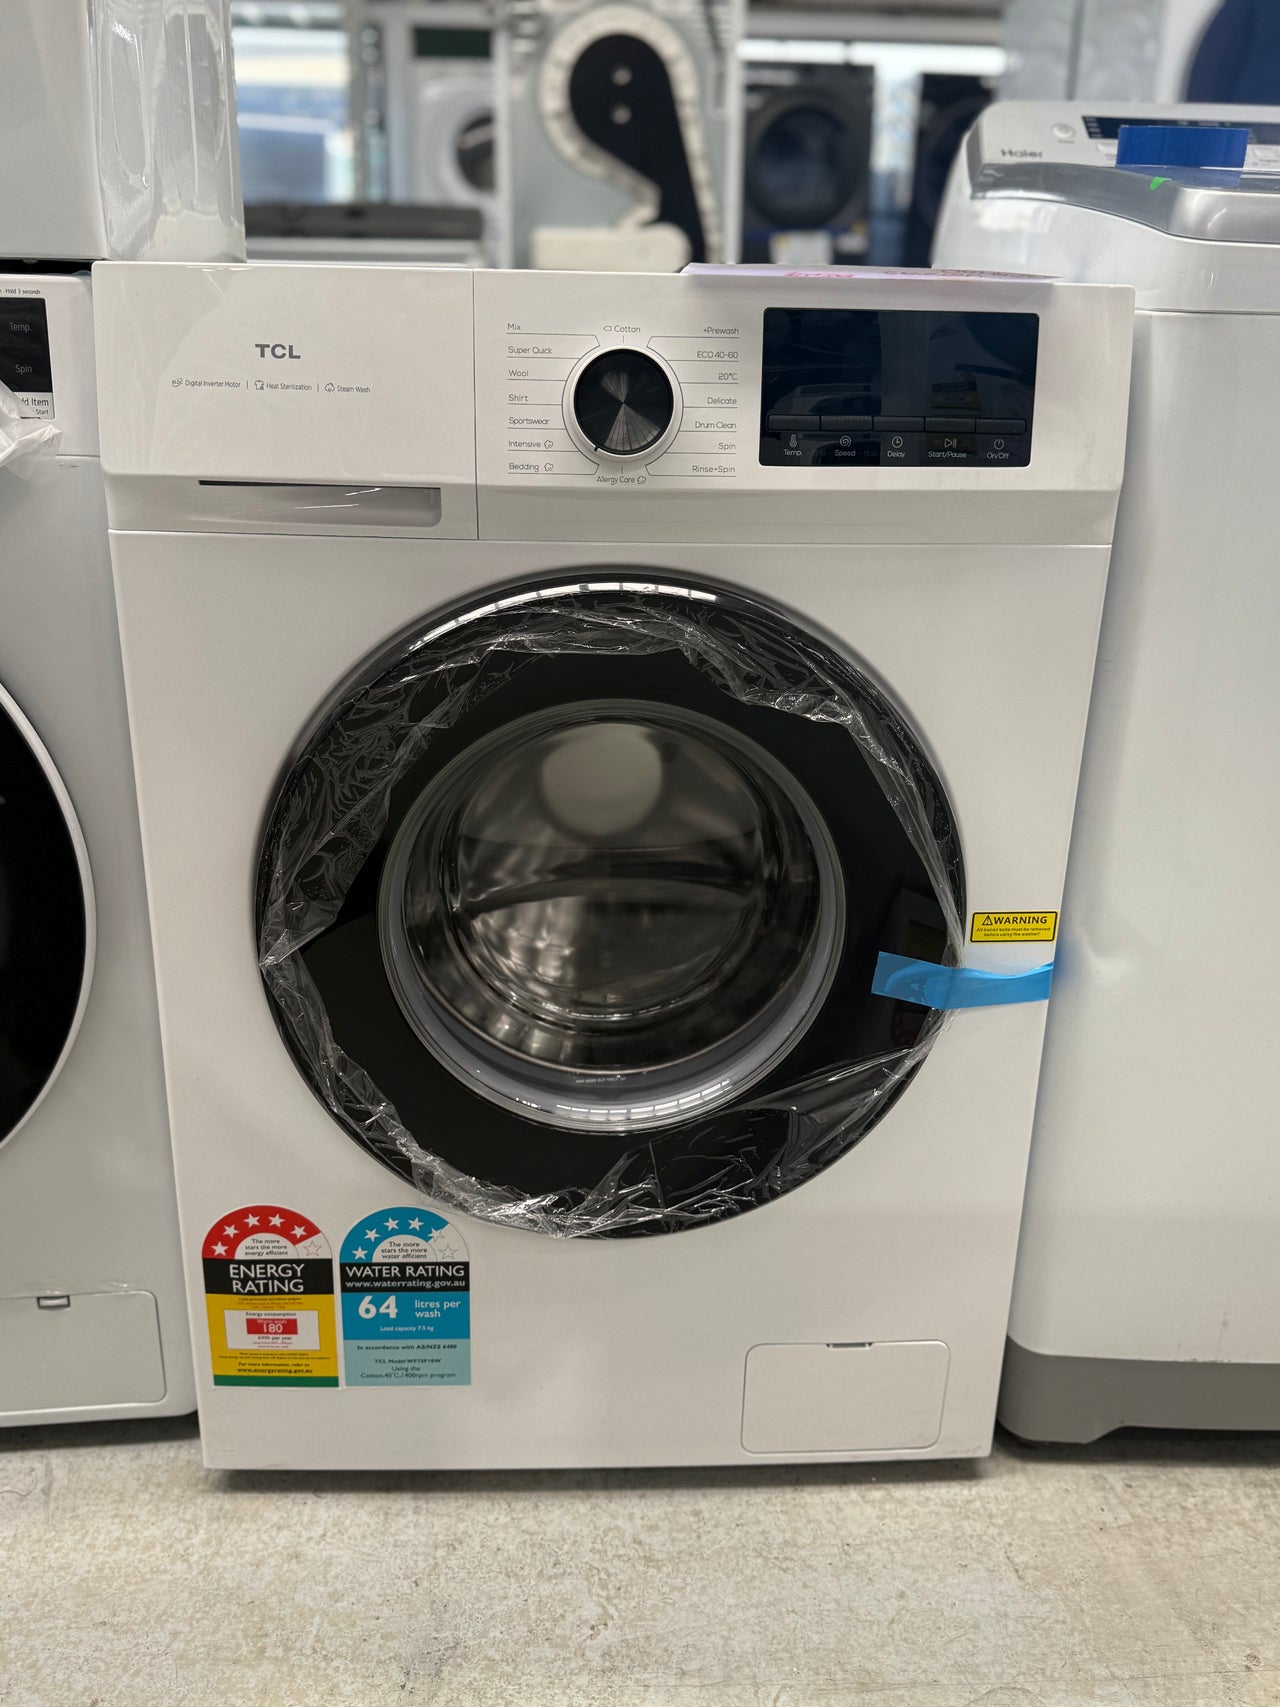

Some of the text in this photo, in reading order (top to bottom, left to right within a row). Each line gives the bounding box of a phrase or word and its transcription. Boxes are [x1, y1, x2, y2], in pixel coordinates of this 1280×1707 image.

[1001, 148, 1042, 158] Haier
[9, 322, 32, 333] Temp.
[507, 323, 521, 331] Mix
[614, 325, 641, 333] Cotton
[704, 327, 739, 335] +Prewash
[255, 343, 301, 360] TCL
[508, 347, 553, 355] Super Quick
[697, 351, 738, 359] ECO 40-60
[15, 364, 32, 374] Spin
[185, 380, 202, 388] Digital
[31, 398, 49, 406] Item
[707, 397, 737, 405] Delicate
[509, 417, 550, 426] Sportswear
[509, 440, 541, 448] Intensive
[719, 442, 736, 451] Spin
[784, 448, 802, 457] Temp.
[834, 448, 856, 458] Speed
[887, 450, 905, 458] Delay
[928, 450, 967, 458] Start/Pause
[986, 452, 1009, 460] On/Off
[509, 463, 539, 472] Bedding
[692, 465, 735, 473] Rinse+Spin
[597, 476, 635, 485] Allergy Care
[994, 916, 1048, 924] WARNING
[229, 1264, 305, 1278] ENERGY
[346, 1265, 465, 1277] WATER RATING
[232, 1279, 304, 1293] RATING
[346, 1280, 465, 1289] www.waterrating.gov.au
[358, 1295, 398, 1319] 64
[414, 1300, 461, 1311] litres per
[415, 1310, 440, 1318] wash
[263, 1323, 283, 1333] 180
